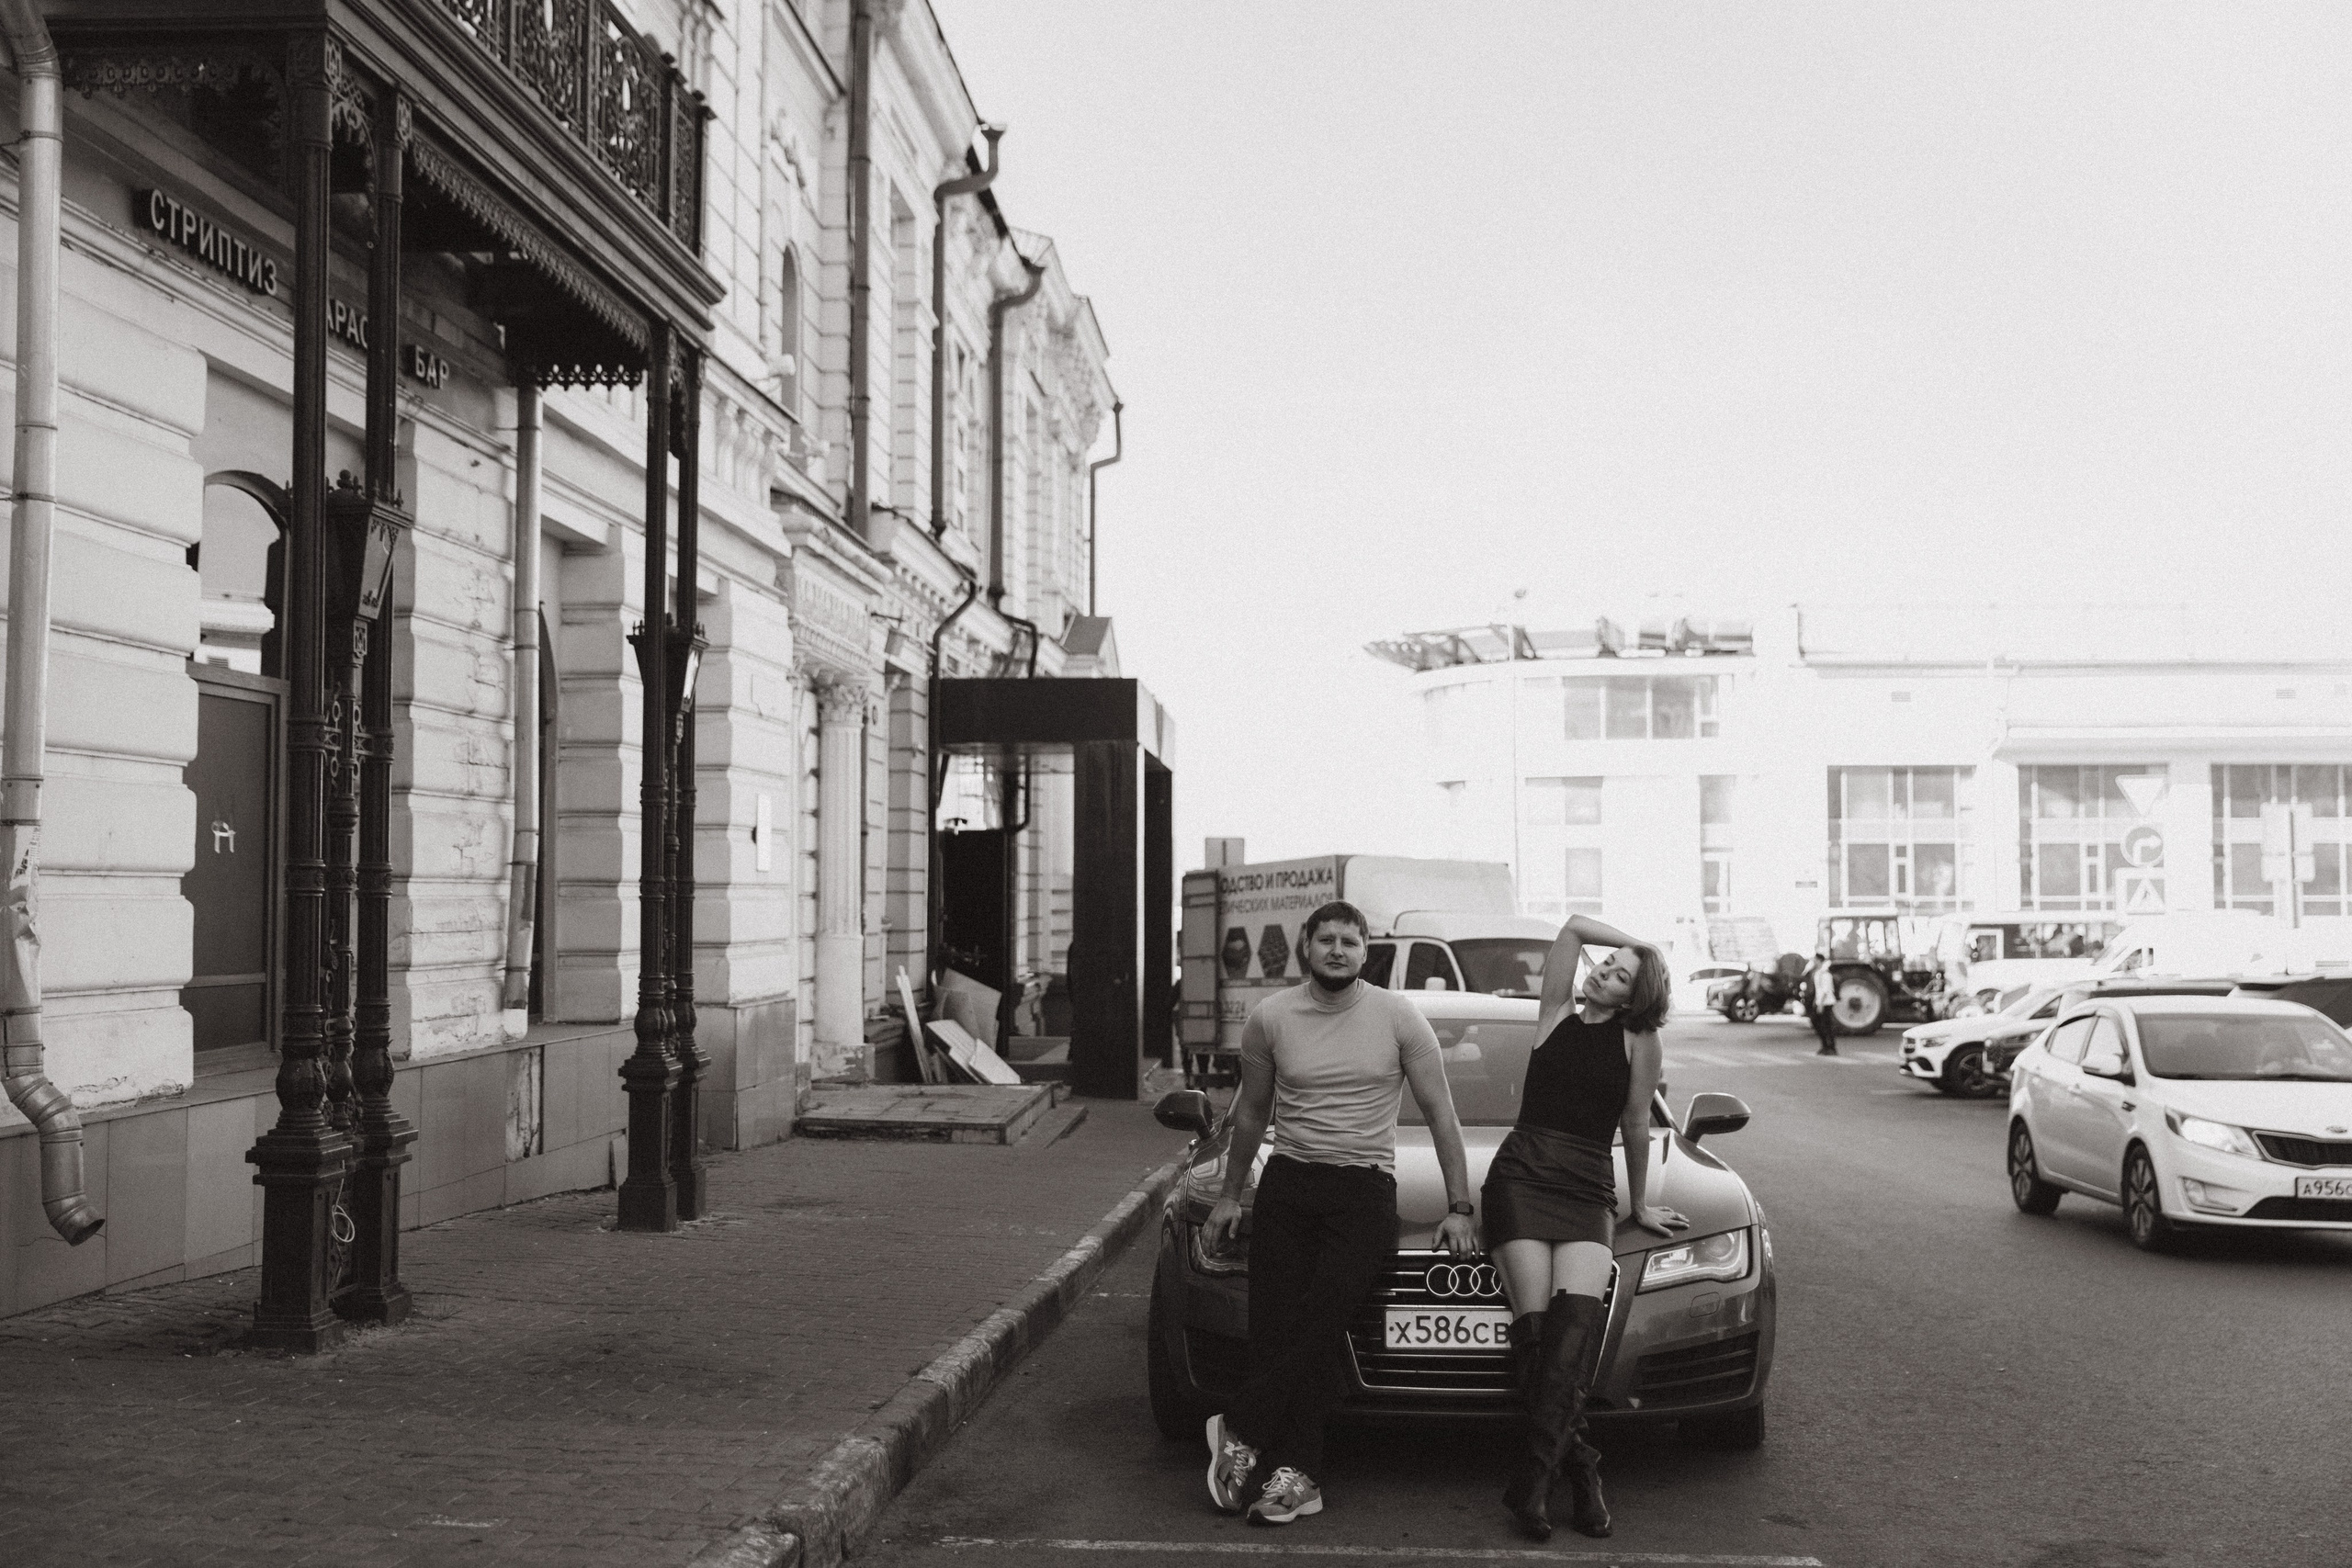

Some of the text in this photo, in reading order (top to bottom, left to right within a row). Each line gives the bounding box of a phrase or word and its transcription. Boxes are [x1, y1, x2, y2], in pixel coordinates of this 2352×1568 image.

[150, 188, 277, 296] СТРИПТИЗ
[414, 344, 450, 389] БАР
[1220, 874, 1264, 895] ОДСТВО
[1276, 867, 1334, 888] ПРОДАЖА
